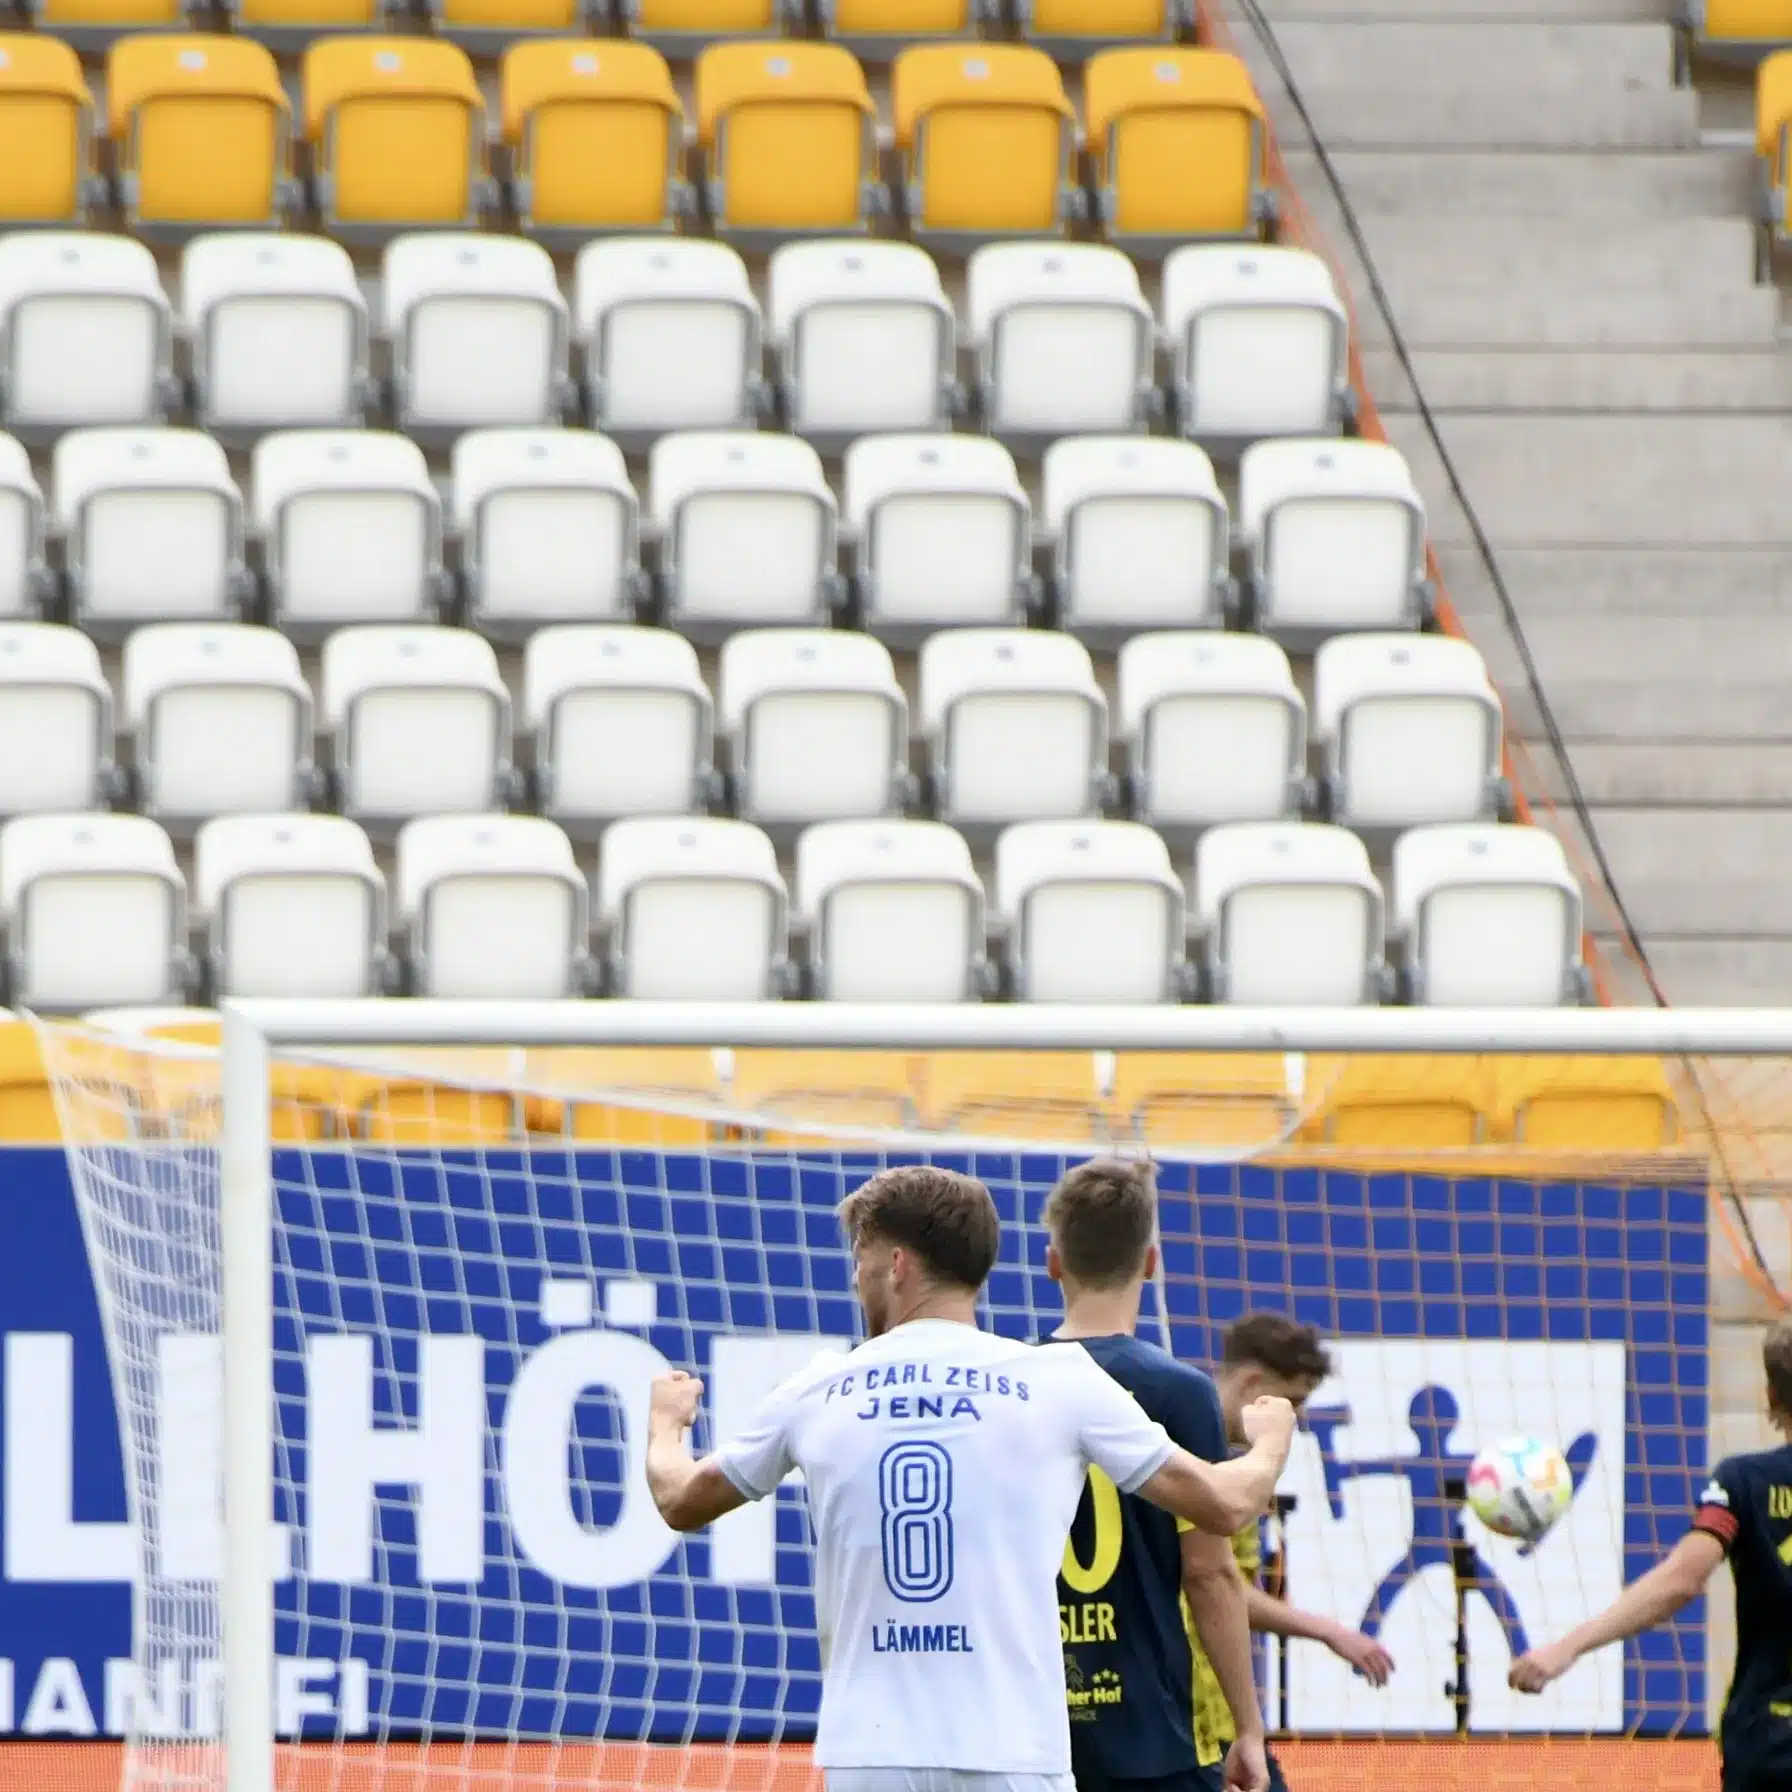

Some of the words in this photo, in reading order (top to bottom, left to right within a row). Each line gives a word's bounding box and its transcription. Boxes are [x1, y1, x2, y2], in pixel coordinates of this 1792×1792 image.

[825, 1376, 855, 1404] FC
[866, 1363, 933, 1391] CARL
[945, 1366, 1030, 1401] ZEISS
[857, 1396, 982, 1421] JENA
[878, 1440, 954, 1603] 8
[872, 1618, 974, 1653] LÄMMEL
